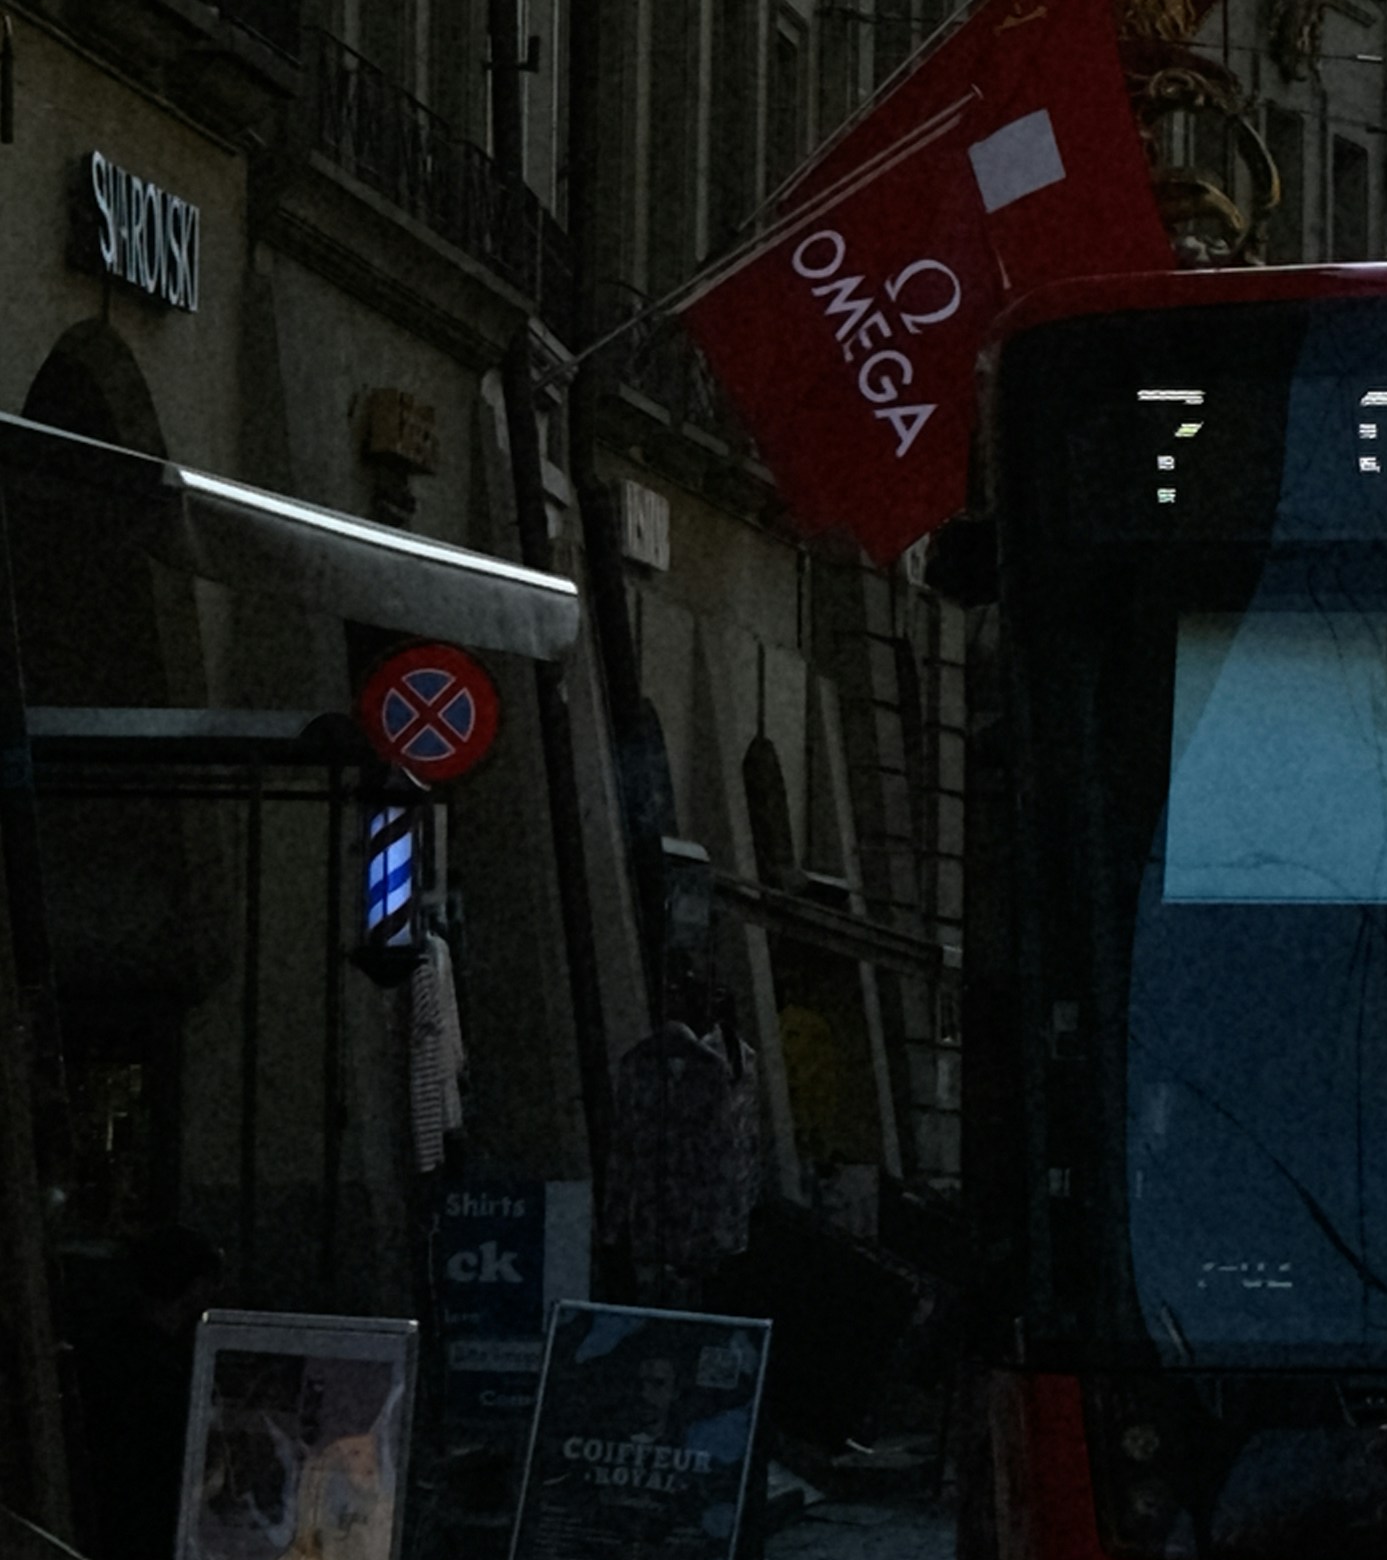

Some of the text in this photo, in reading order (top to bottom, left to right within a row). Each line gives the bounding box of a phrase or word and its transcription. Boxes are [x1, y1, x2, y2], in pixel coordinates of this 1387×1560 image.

[791, 229, 938, 459] OMEGA
[445, 1191, 526, 1217] Shirts
[562, 1436, 713, 1474] COIFFEUR
